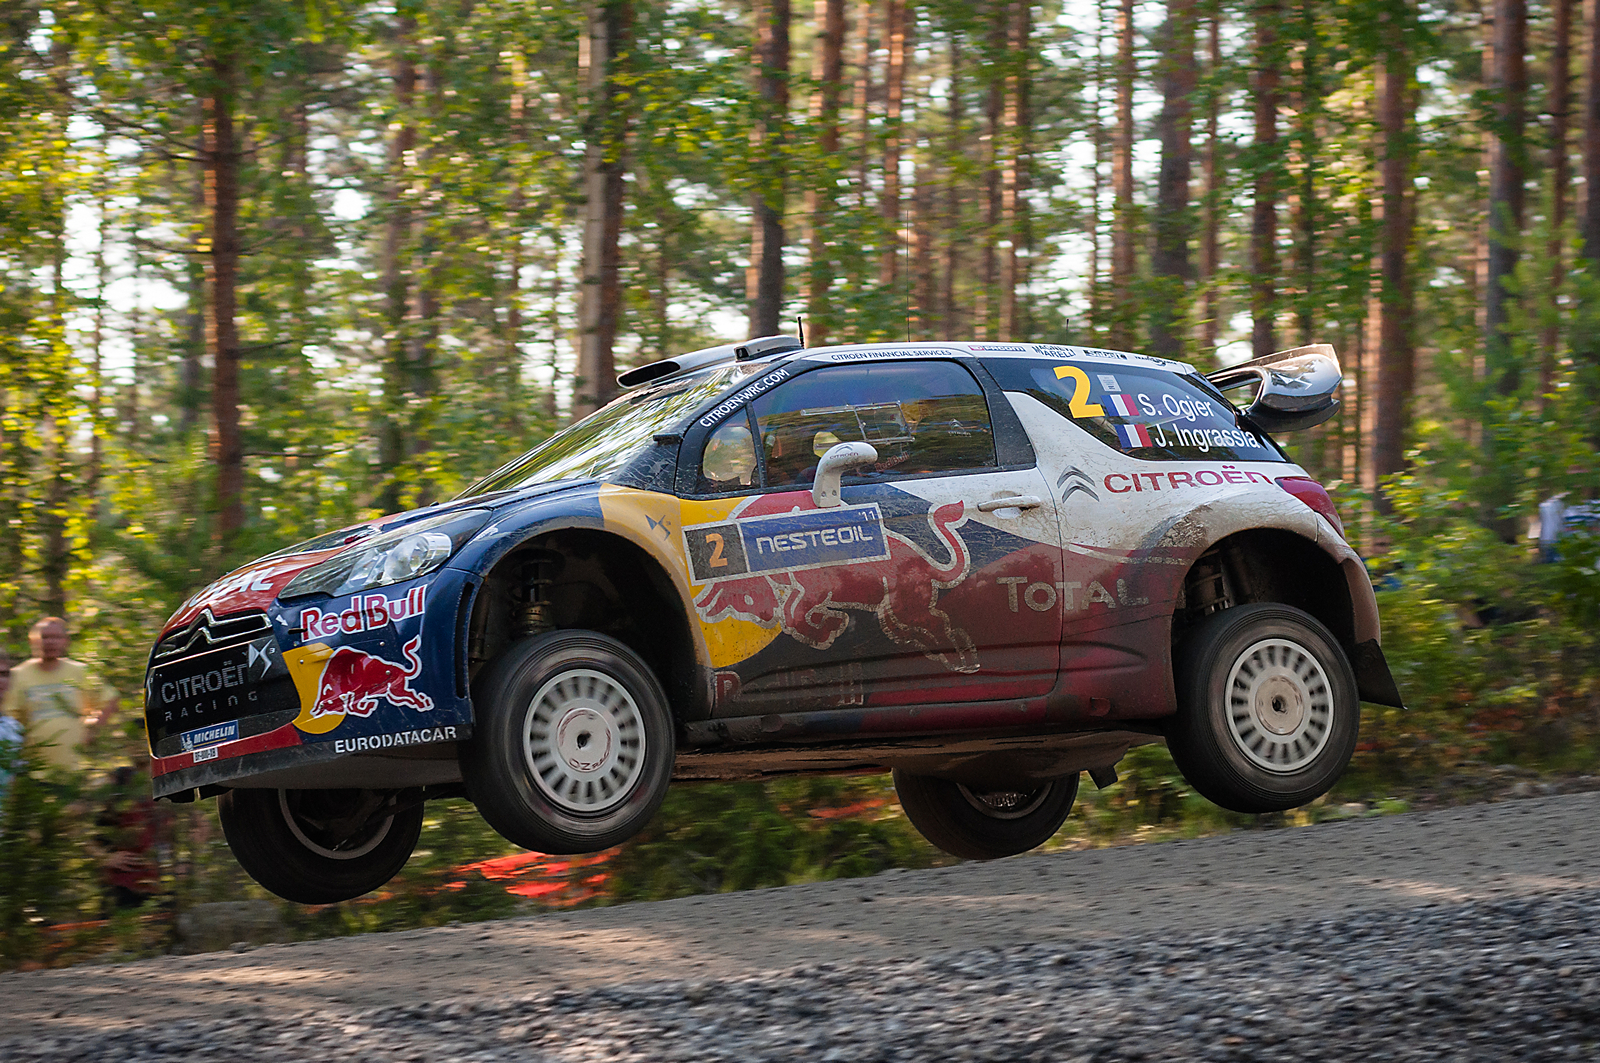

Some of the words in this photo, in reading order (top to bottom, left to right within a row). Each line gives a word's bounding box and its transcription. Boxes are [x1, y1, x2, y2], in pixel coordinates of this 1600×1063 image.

[868, 350, 913, 358] FINANCIAL
[914, 349, 952, 357] SERVICES
[700, 368, 790, 428] CITROEN-WRC.COM
[1053, 365, 1106, 419] 2
[1137, 393, 1163, 417] S.
[1163, 393, 1213, 423] Ogier
[1155, 425, 1173, 448] J.
[1173, 422, 1261, 453] Ingrassia
[1103, 465, 1274, 494] CITROËN
[705, 533, 728, 568] 2
[996, 576, 1149, 613] TOTAL
[300, 594, 366, 642] Red
[364, 584, 428, 629] Bull
[164, 690, 258, 721] RACING
[194, 725, 236, 744] MICHELIN
[334, 725, 457, 753] EURODATACAR
